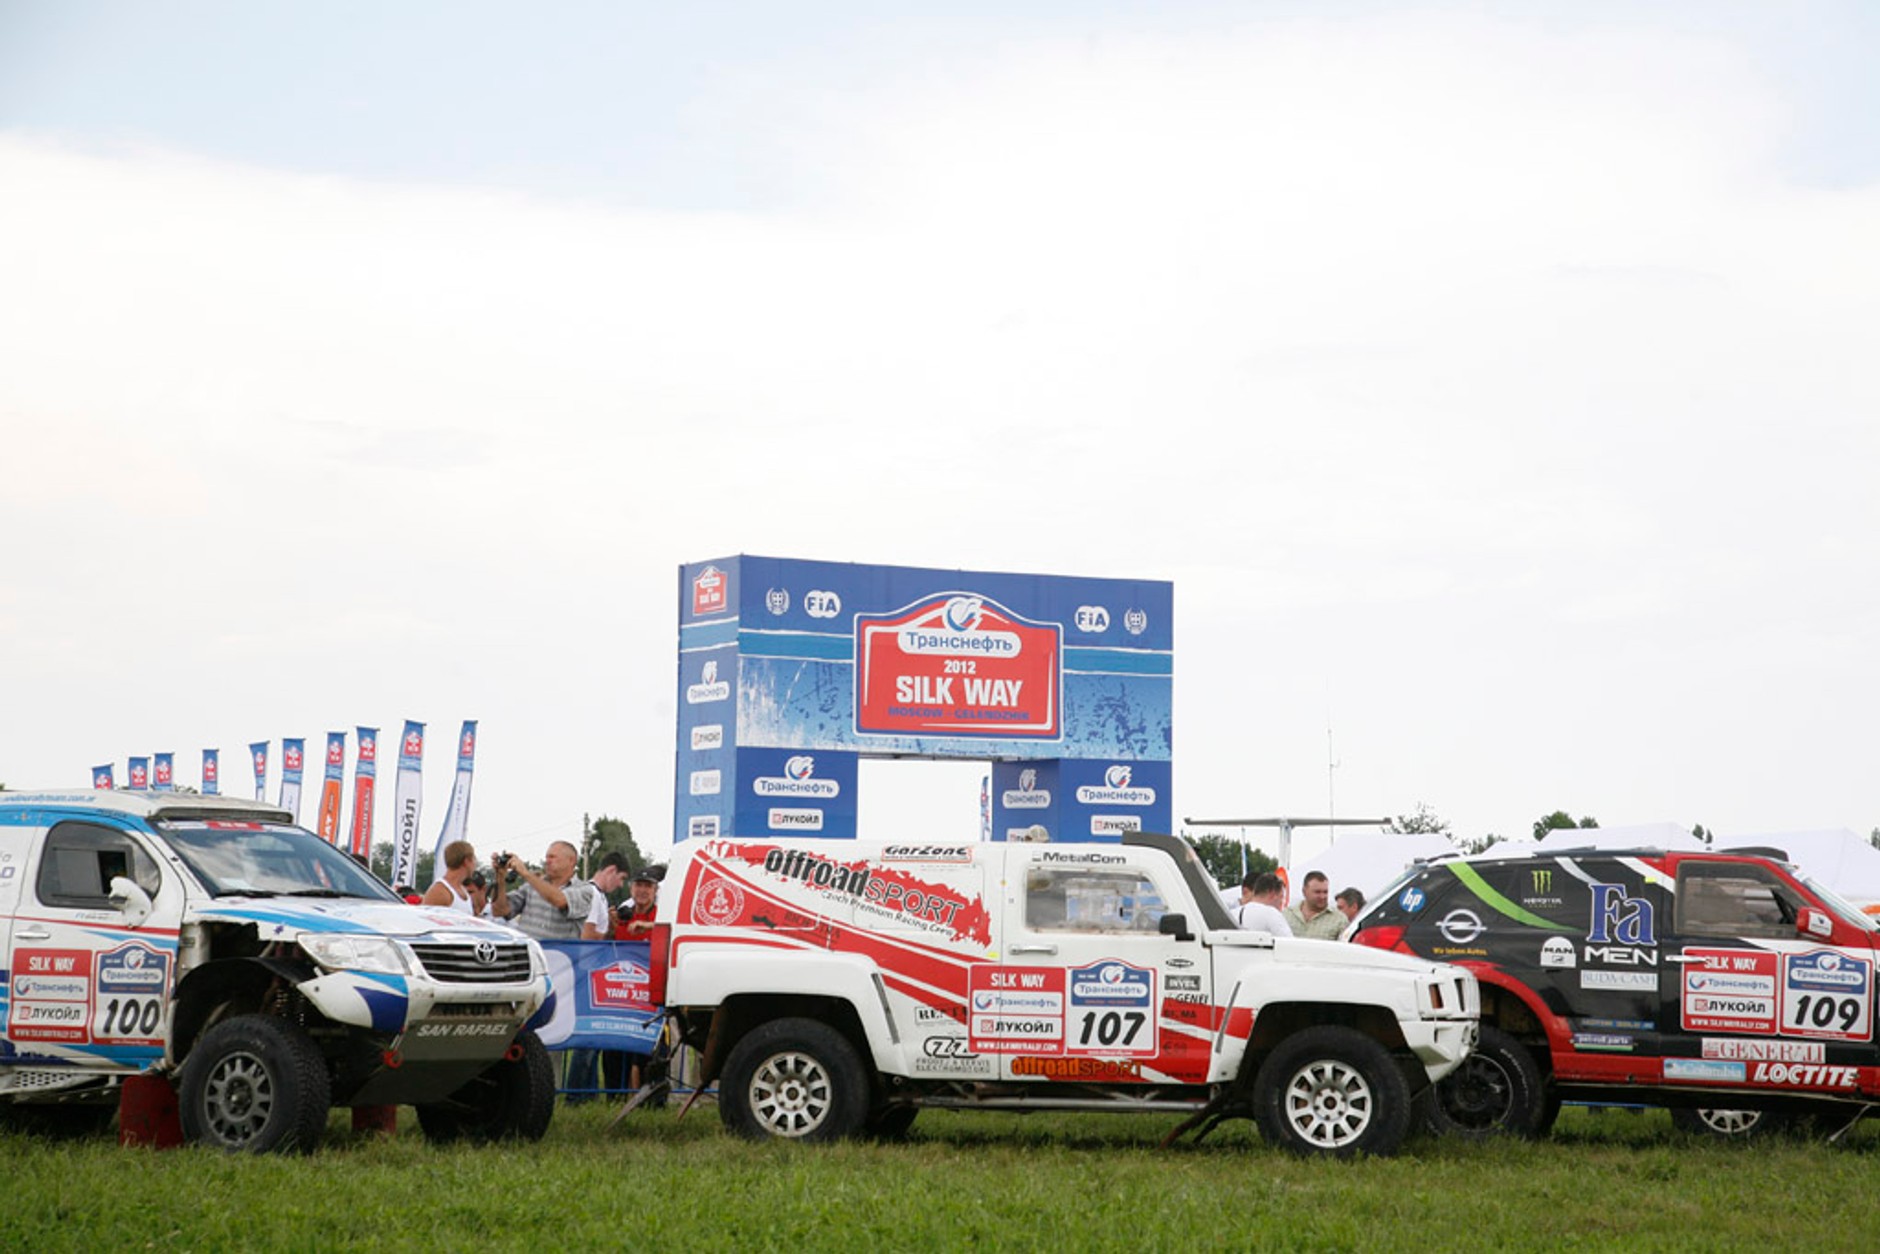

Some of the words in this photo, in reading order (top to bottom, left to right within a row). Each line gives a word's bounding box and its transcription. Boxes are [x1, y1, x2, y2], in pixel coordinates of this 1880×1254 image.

[906, 631, 1013, 652] Транснефть
[943, 659, 976, 675] 2012
[895, 675, 955, 705] SILK
[963, 678, 1024, 708] WAY
[760, 780, 834, 794] Транснефть
[1083, 789, 1151, 802] Транснефть
[781, 812, 820, 825] ЛУКОЙЛ
[397, 798, 416, 885] ЛУКОЙЛ
[1043, 851, 1127, 865] MetalCom
[1402, 887, 1423, 913] hp
[1586, 883, 1658, 946] Fa
[1584, 945, 1658, 966] MEN
[29, 956, 51, 971] SILK
[54, 957, 75, 972] WAY
[1704, 956, 1729, 969] SILK
[1733, 957, 1758, 971] WAY
[991, 972, 1017, 987] SILK
[1021, 973, 1046, 988] WAY
[1796, 969, 1860, 982] Транснефть
[31, 982, 84, 994] Транснефть
[1079, 984, 1143, 994] Транснефть
[1708, 978, 1769, 990] Транснефть
[995, 996, 1058, 1008] Транснефть
[1709, 1000, 1766, 1013] ЛУКОЙЛ
[31, 1006, 81, 1020] ЛУКОЙЛ
[103, 998, 161, 1035] 100
[1795, 995, 1861, 1032] 109
[417, 1024, 453, 1037] SAN
[453, 1024, 509, 1036] RAFAEL
[995, 1020, 1054, 1033] ЛУКОЙЛ
[1080, 1011, 1147, 1046] 107
[1753, 1062, 1859, 1088] LOCTITE
